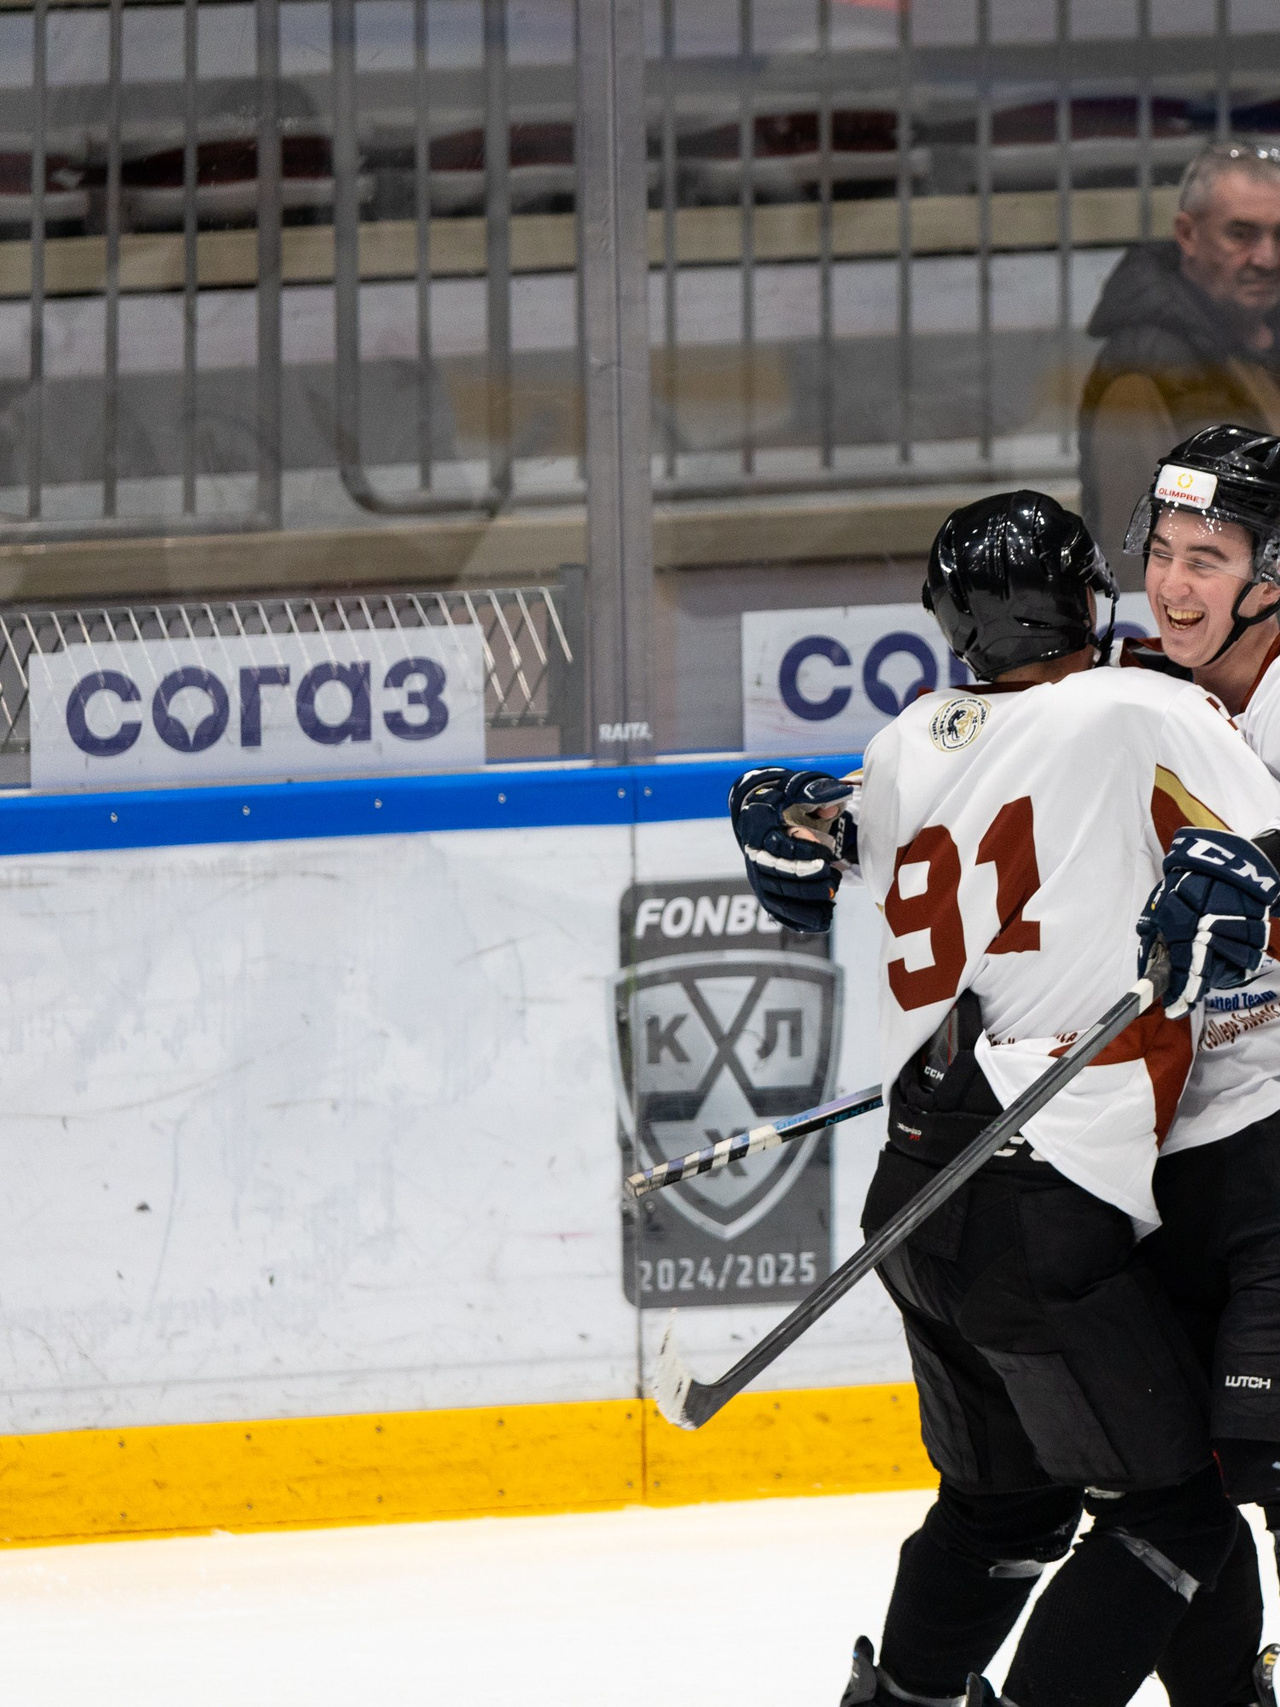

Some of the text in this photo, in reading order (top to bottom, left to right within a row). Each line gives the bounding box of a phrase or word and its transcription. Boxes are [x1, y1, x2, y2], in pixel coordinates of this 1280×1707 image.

[1158, 487, 1206, 504] OLIMPBET
[885, 796, 1041, 1012] 91
[1241, 990, 1278, 1010] Team
[924, 1065, 945, 1081] CCM
[824, 1098, 883, 1127] NEXUS
[638, 1251, 817, 1293] 2024/2025
[1225, 1375, 1271, 1390] LUTCH
